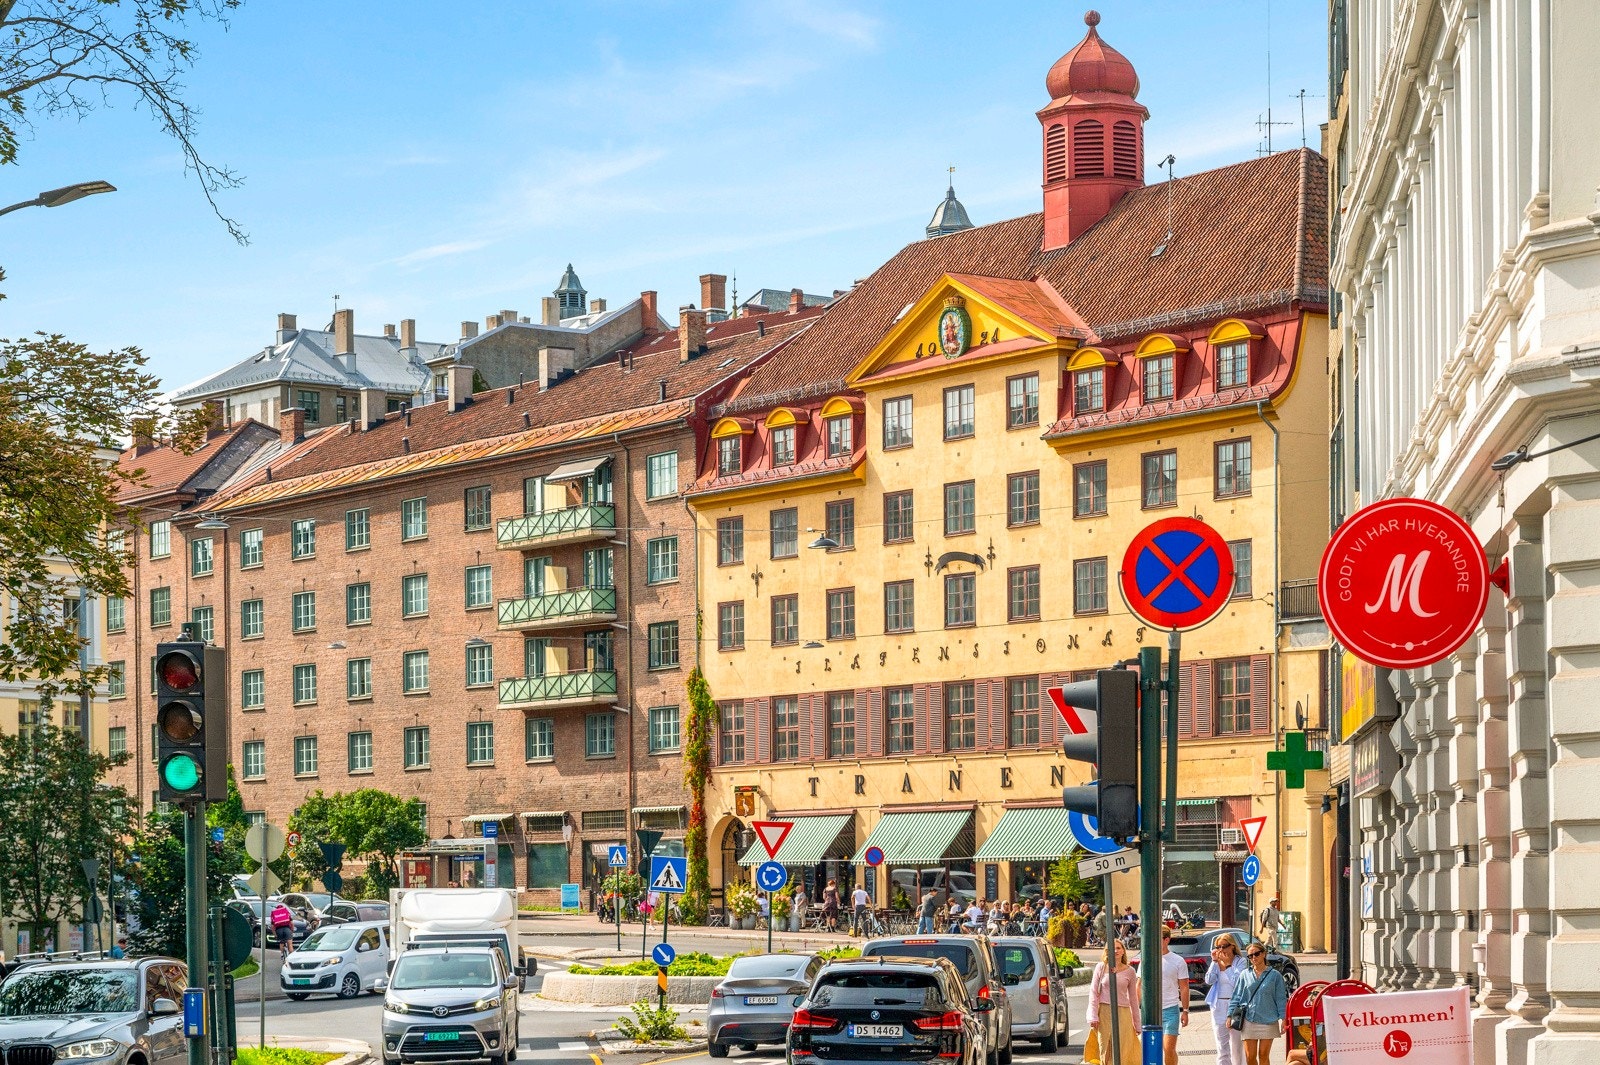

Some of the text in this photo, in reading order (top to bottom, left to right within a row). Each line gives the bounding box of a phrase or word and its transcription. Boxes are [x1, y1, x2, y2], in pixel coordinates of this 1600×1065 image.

[1338, 518, 1470, 602] GODT VI HAR HVERANDRE
[1364, 549, 1441, 618] M
[808, 764, 1066, 797] TRANEN
[1095, 855, 1126, 871] 50 m
[856, 1025, 901, 1036] DS 14462
[1339, 1005, 1456, 1028] Velkommen!
